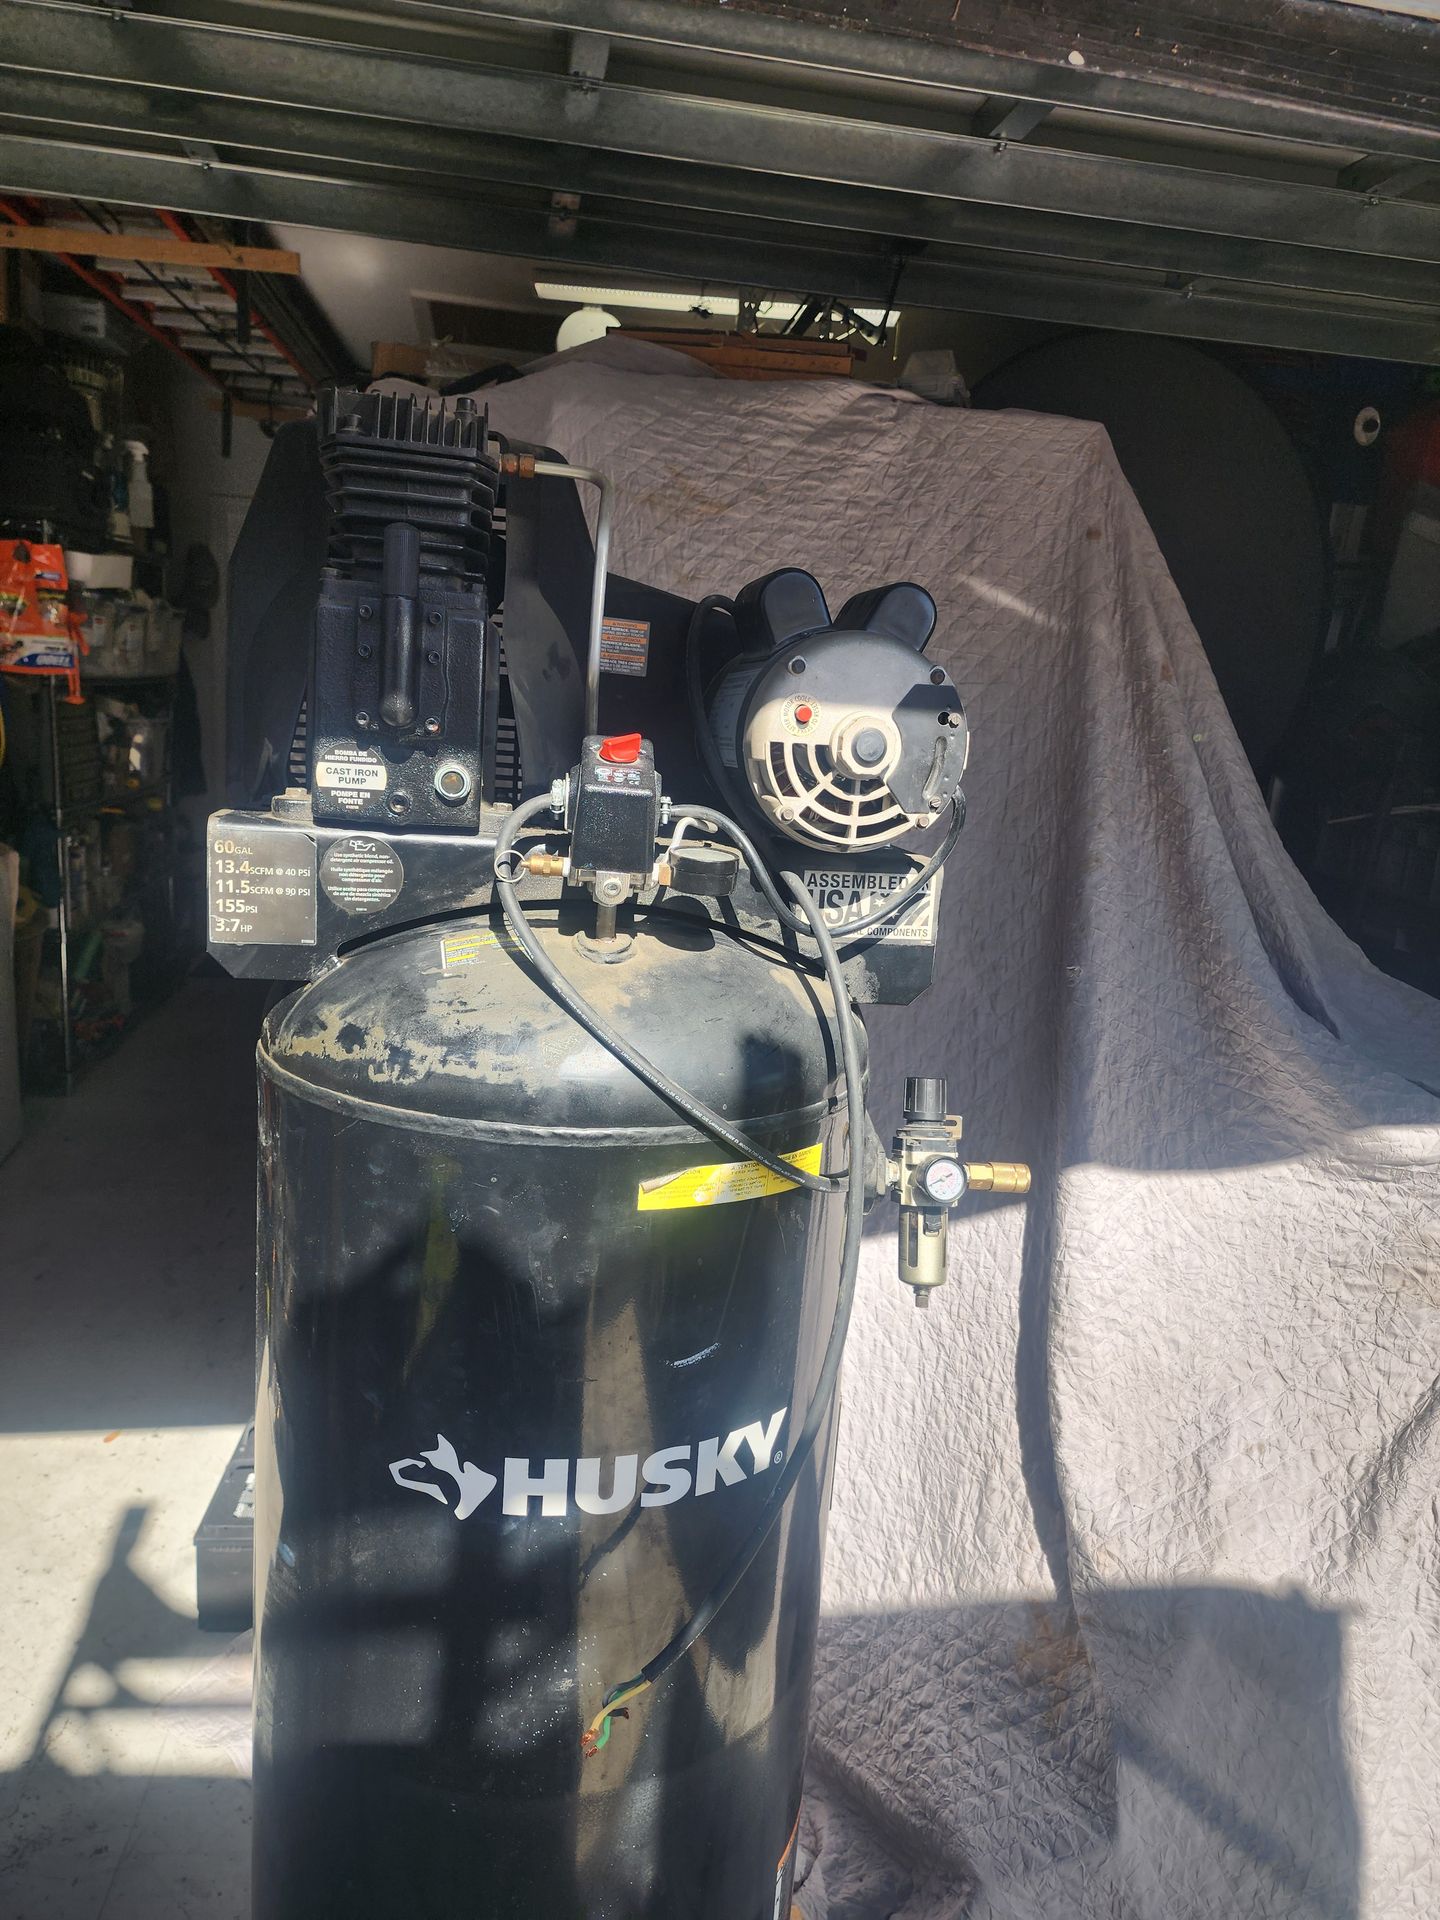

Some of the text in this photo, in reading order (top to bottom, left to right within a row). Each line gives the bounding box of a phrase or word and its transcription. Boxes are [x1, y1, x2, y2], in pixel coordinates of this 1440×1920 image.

[326, 767, 378, 776] CAST IRON
[338, 776, 366, 784] PUMP
[330, 790, 358, 798] POMPE
[276, 866, 284, 876] @
[285, 868, 296, 876] 40
[298, 869, 310, 877] PSI
[807, 872, 908, 890] ASSEMBLED
[286, 888, 296, 896] 90
[868, 928, 928, 937] COMPONENTS
[502, 1407, 787, 1516] HUSKY
